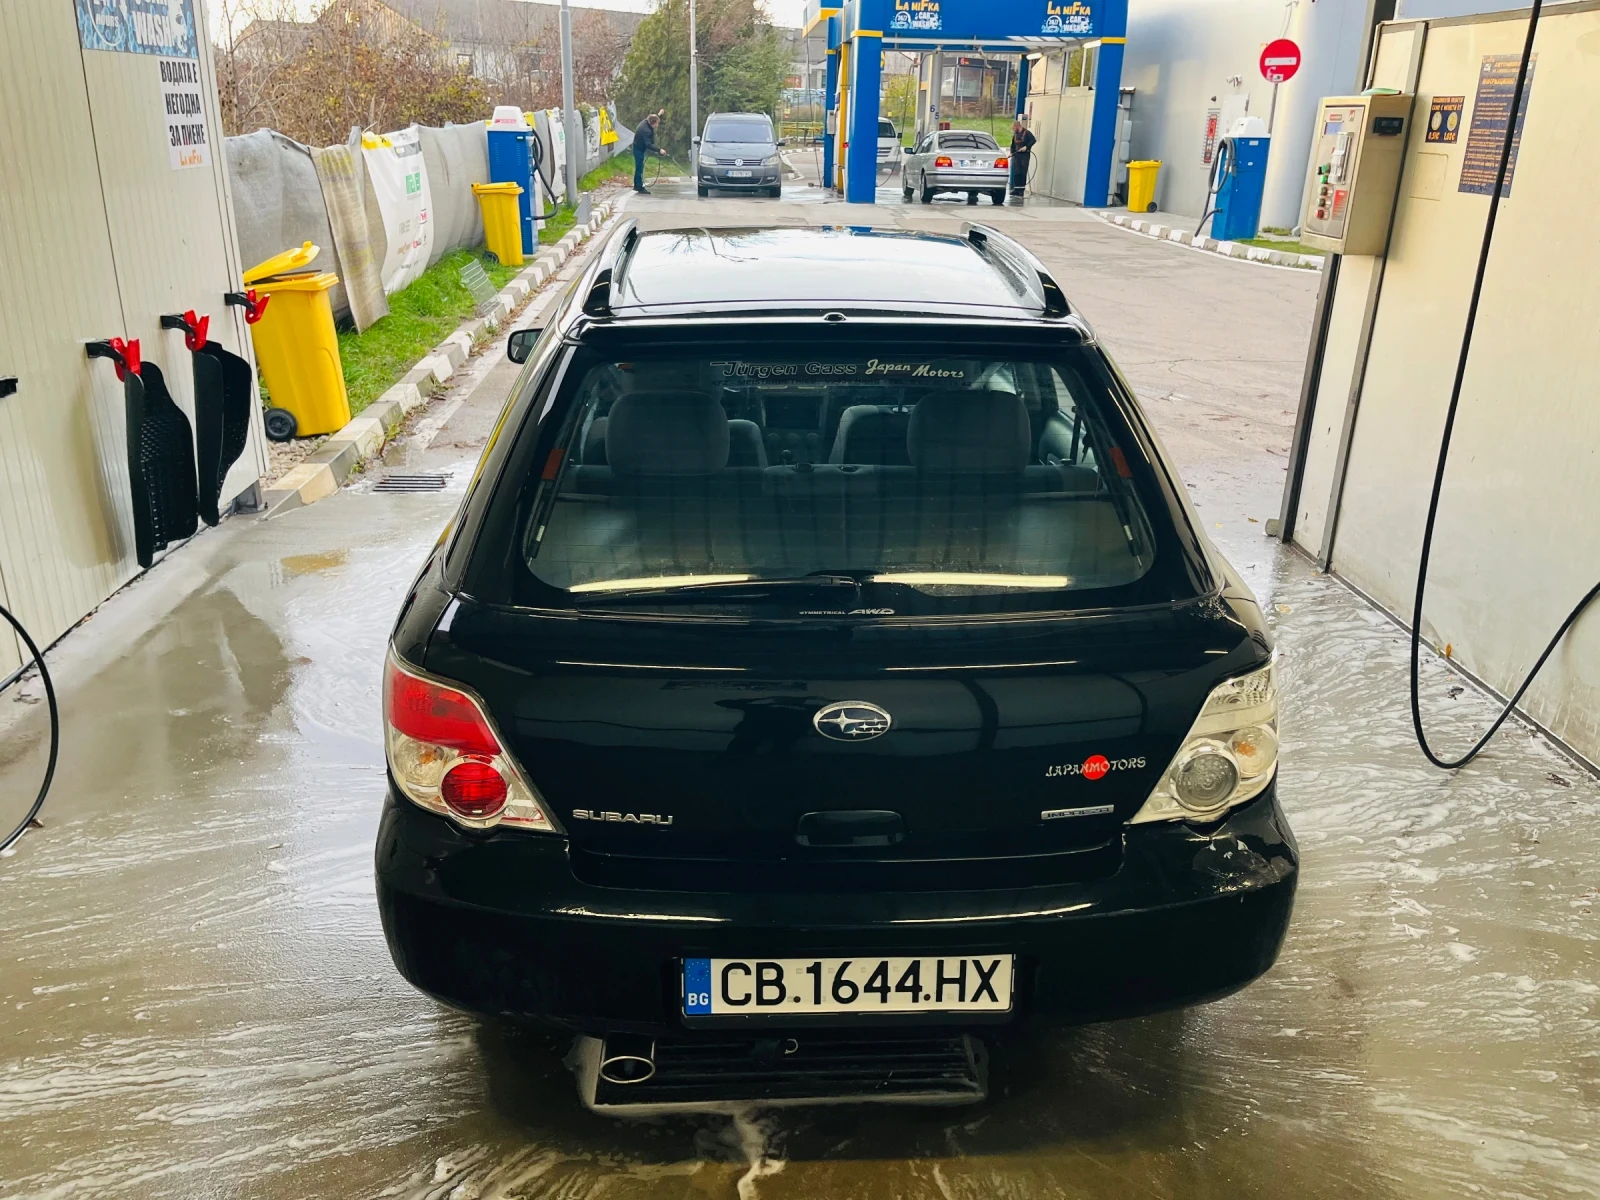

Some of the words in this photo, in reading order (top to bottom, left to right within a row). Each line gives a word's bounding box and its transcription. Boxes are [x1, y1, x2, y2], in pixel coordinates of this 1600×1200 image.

[132, 11, 171, 46] WASH
[160, 61, 192, 86] ВОДАТА
[192, 63, 198, 83] Е
[165, 93, 201, 117] НЕГОДНА
[169, 125, 182, 146] ЗА
[181, 124, 205, 146] ПИЕНЕ
[710, 362, 798, 378] Jürgen
[805, 362, 857, 375] Gass
[865, 359, 911, 374] Japan
[912, 365, 965, 378] Motors
[572, 808, 673, 825] SUBARU
[688, 993, 708, 1006] BG
